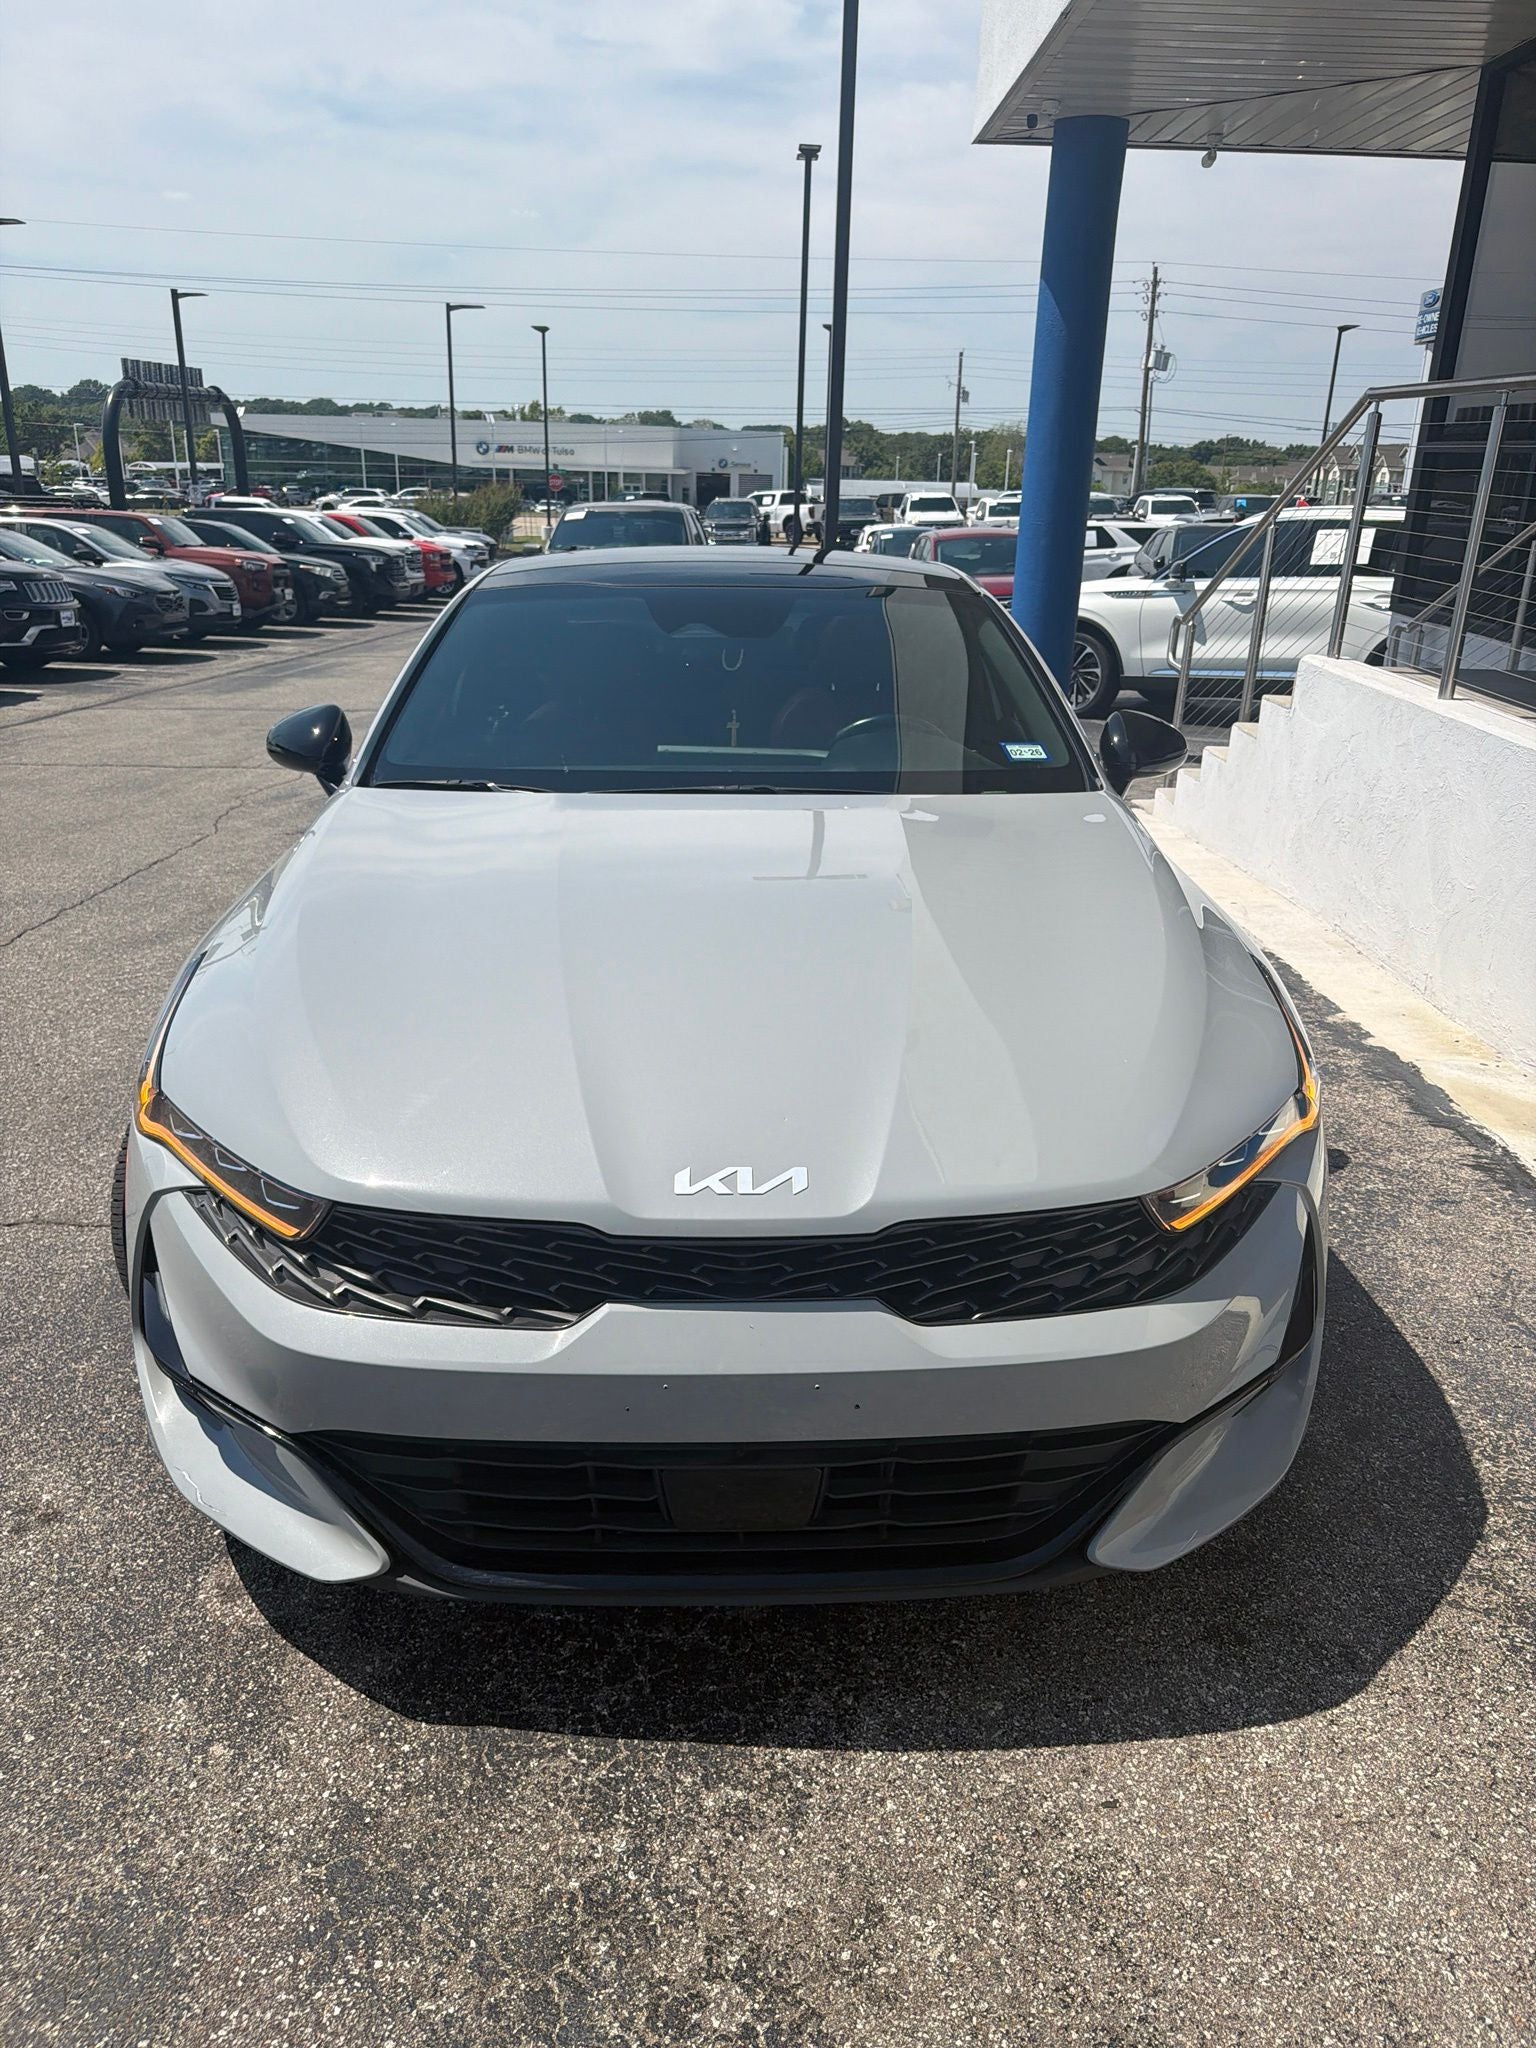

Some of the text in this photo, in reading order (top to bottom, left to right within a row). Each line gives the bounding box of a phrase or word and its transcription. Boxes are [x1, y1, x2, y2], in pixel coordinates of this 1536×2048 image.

[517, 445, 540, 454] BMW
[551, 446, 575, 456] Tulsa
[673, 1166, 809, 1196] KIA
